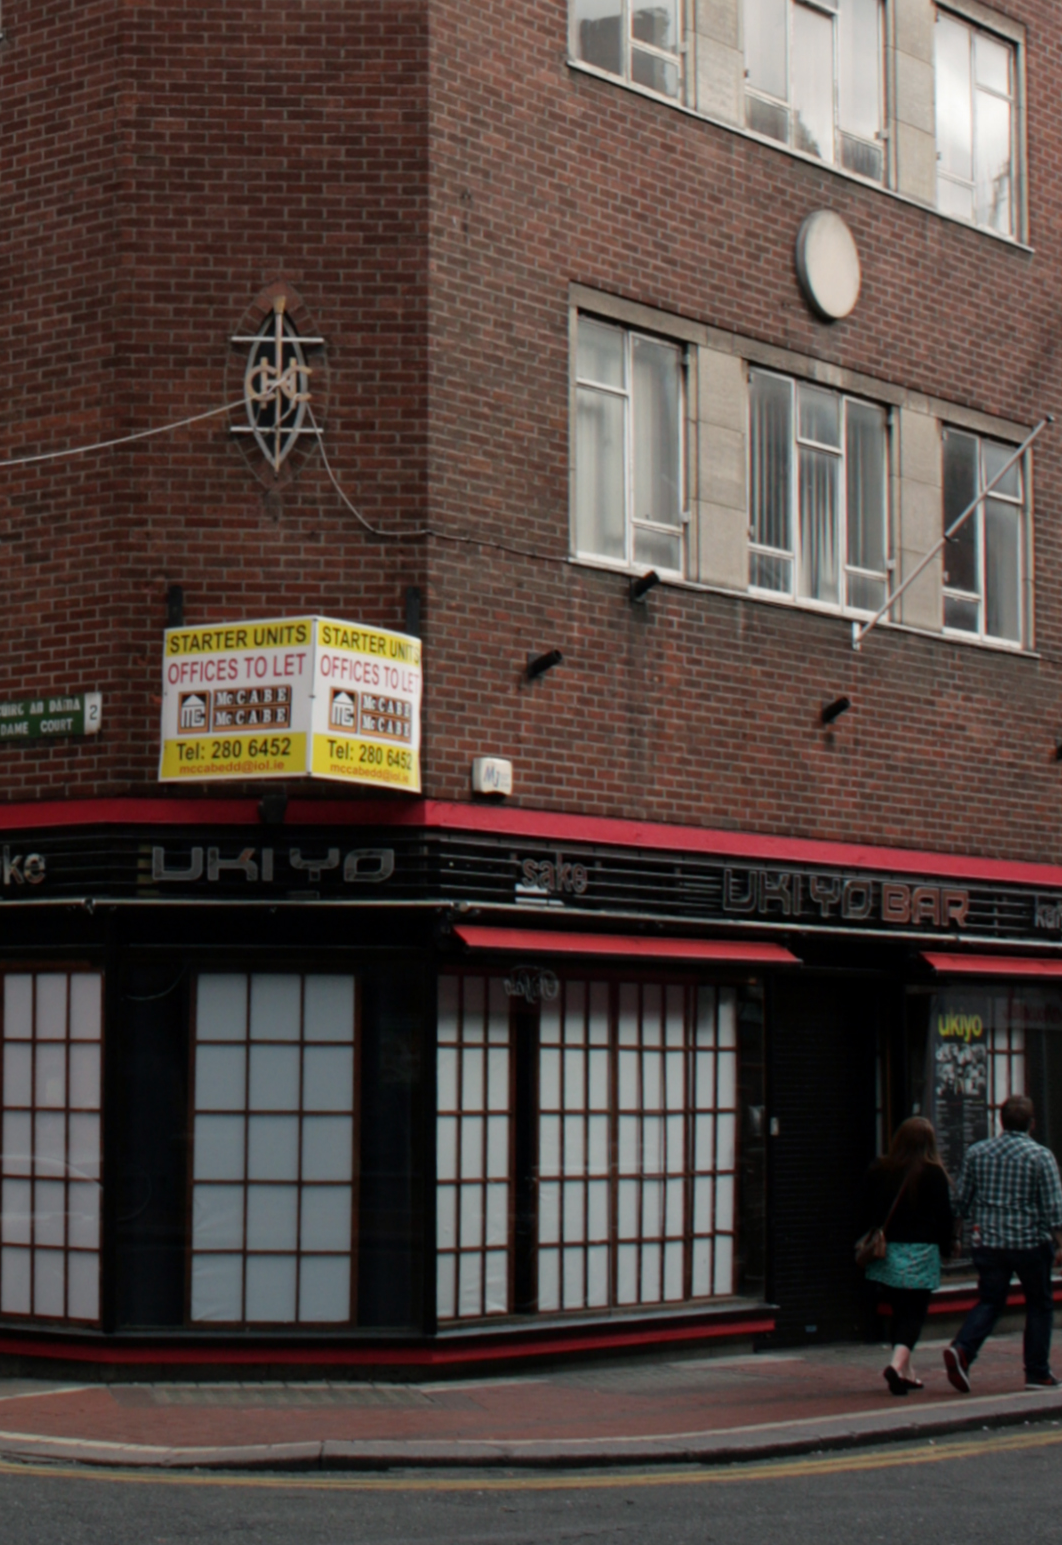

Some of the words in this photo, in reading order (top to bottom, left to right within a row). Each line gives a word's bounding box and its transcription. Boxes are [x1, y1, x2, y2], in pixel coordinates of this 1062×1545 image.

[170, 629, 247, 654] STARTER
[254, 624, 307, 646] UNITS
[322, 625, 386, 654] STARTER
[389, 639, 420, 663] UNITS
[167, 658, 238, 685] OFFICES
[244, 655, 268, 679] TO
[272, 652, 306, 677] LET
[320, 654, 380, 686] OFFICES
[384, 666, 399, 690] TO
[401, 672, 420, 695] LET
[0, 721, 29, 736] DAME
[40, 717, 73, 733] COURT
[89, 705, 98, 721] 2
[177, 742, 205, 761] Tel:
[211, 740, 242, 760] 280
[248, 737, 291, 758] 6452
[327, 739, 354, 761] Tel:
[358, 744, 384, 766] 280
[386, 749, 412, 771] 6452
[179, 759, 285, 775] mccabedd@iol.ie
[330, 761, 409, 785] mccabedd@iol.ie
[520, 852, 588, 893] sake
[881, 882, 970, 928] BAR
[938, 1011, 983, 1042] ukiyo
